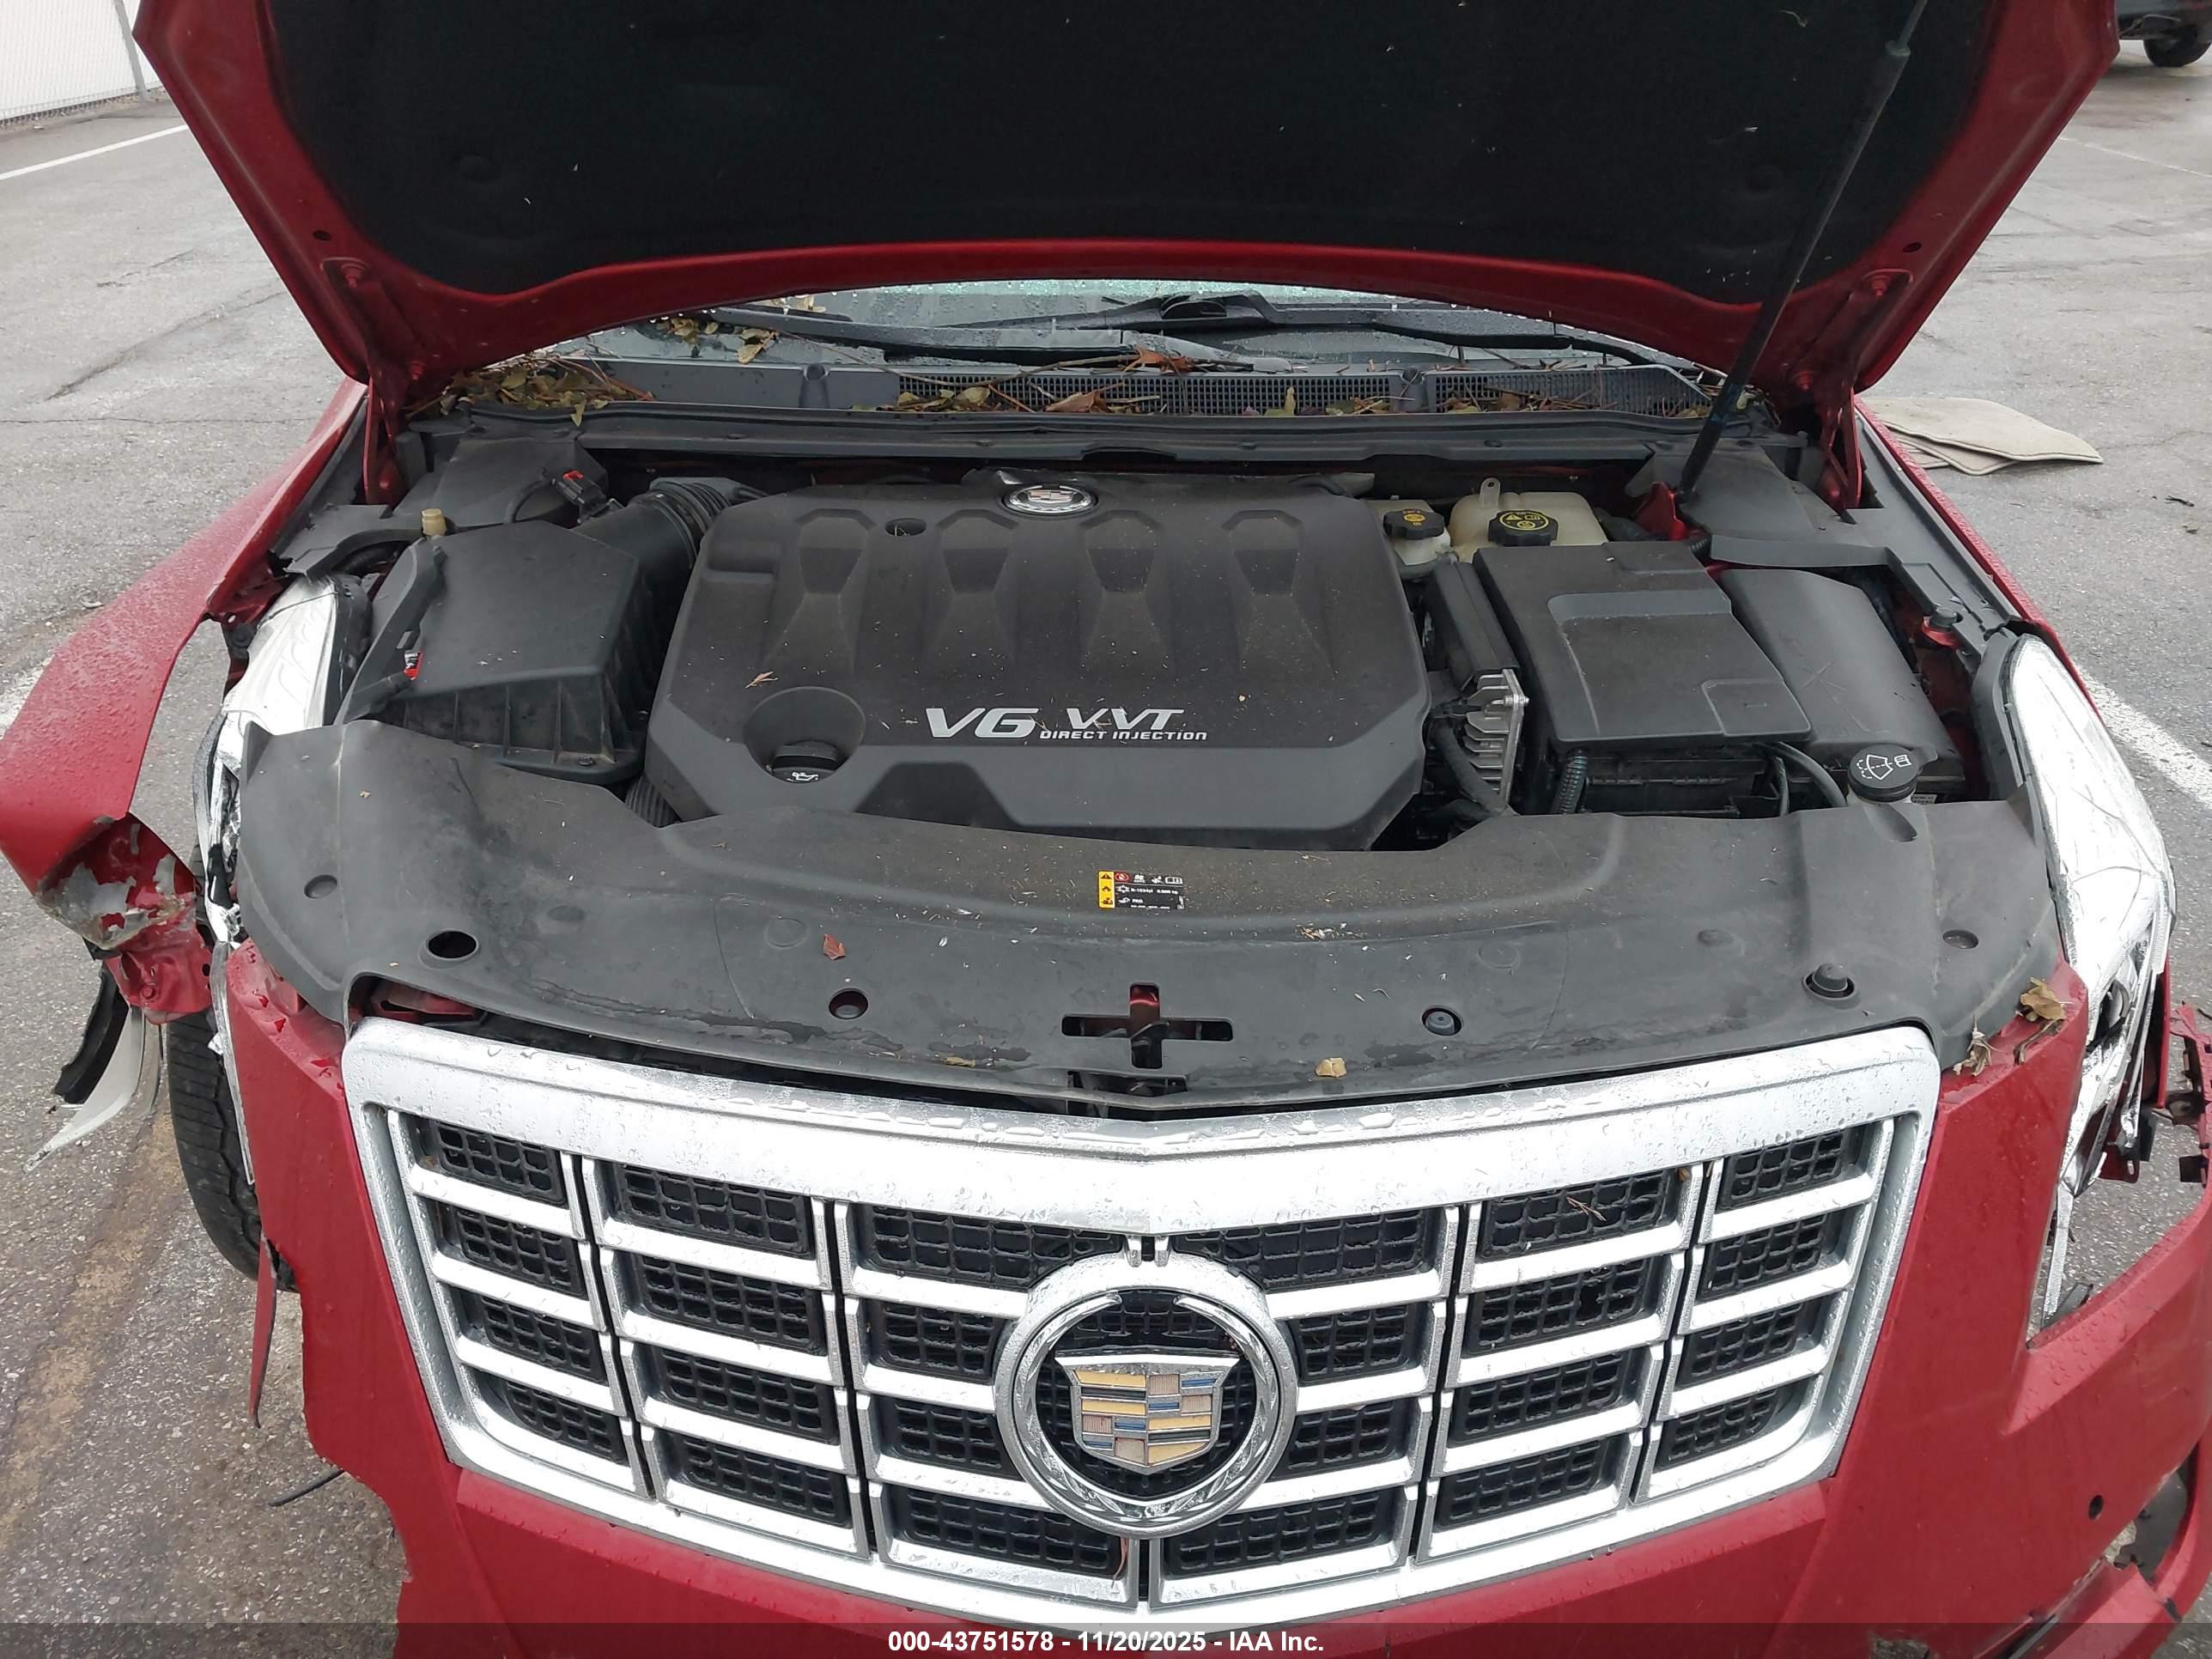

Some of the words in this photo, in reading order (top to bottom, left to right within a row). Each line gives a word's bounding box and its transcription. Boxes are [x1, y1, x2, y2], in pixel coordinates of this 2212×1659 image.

[925, 707, 1040, 738] V6
[1066, 707, 1185, 730] VVT
[1039, 730, 1108, 740] DIRECT
[1112, 731, 1207, 741] INJECTION
